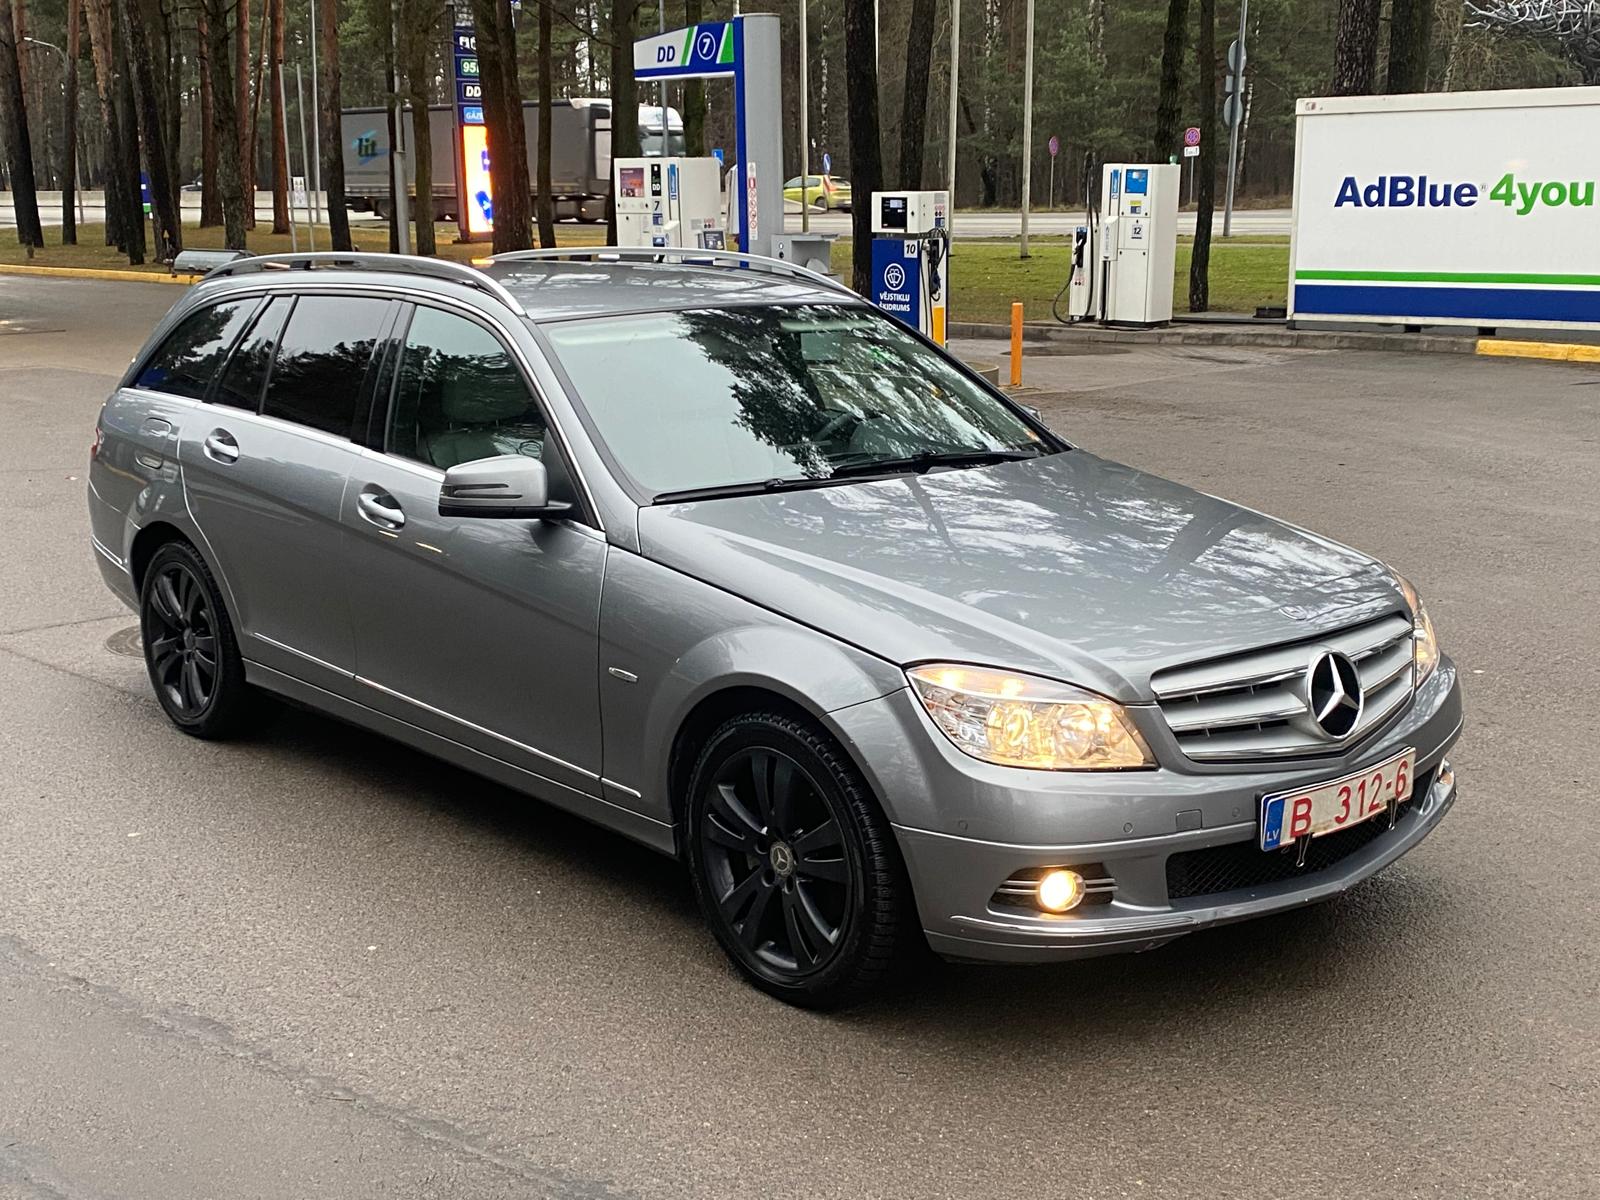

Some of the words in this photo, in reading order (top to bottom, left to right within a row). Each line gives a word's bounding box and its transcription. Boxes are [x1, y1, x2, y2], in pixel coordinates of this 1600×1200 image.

[702, 37, 711, 54] 7
[657, 45, 676, 62] DD
[465, 85, 482, 97] DD
[1489, 173, 1596, 216] 4you
[654, 200, 660, 211] 7
[1133, 227, 1142, 235] 12
[905, 243, 916, 254] 10
[1290, 797, 1313, 838] B
[1335, 760, 1408, 824] 312-6
[1266, 828, 1280, 842] LV
